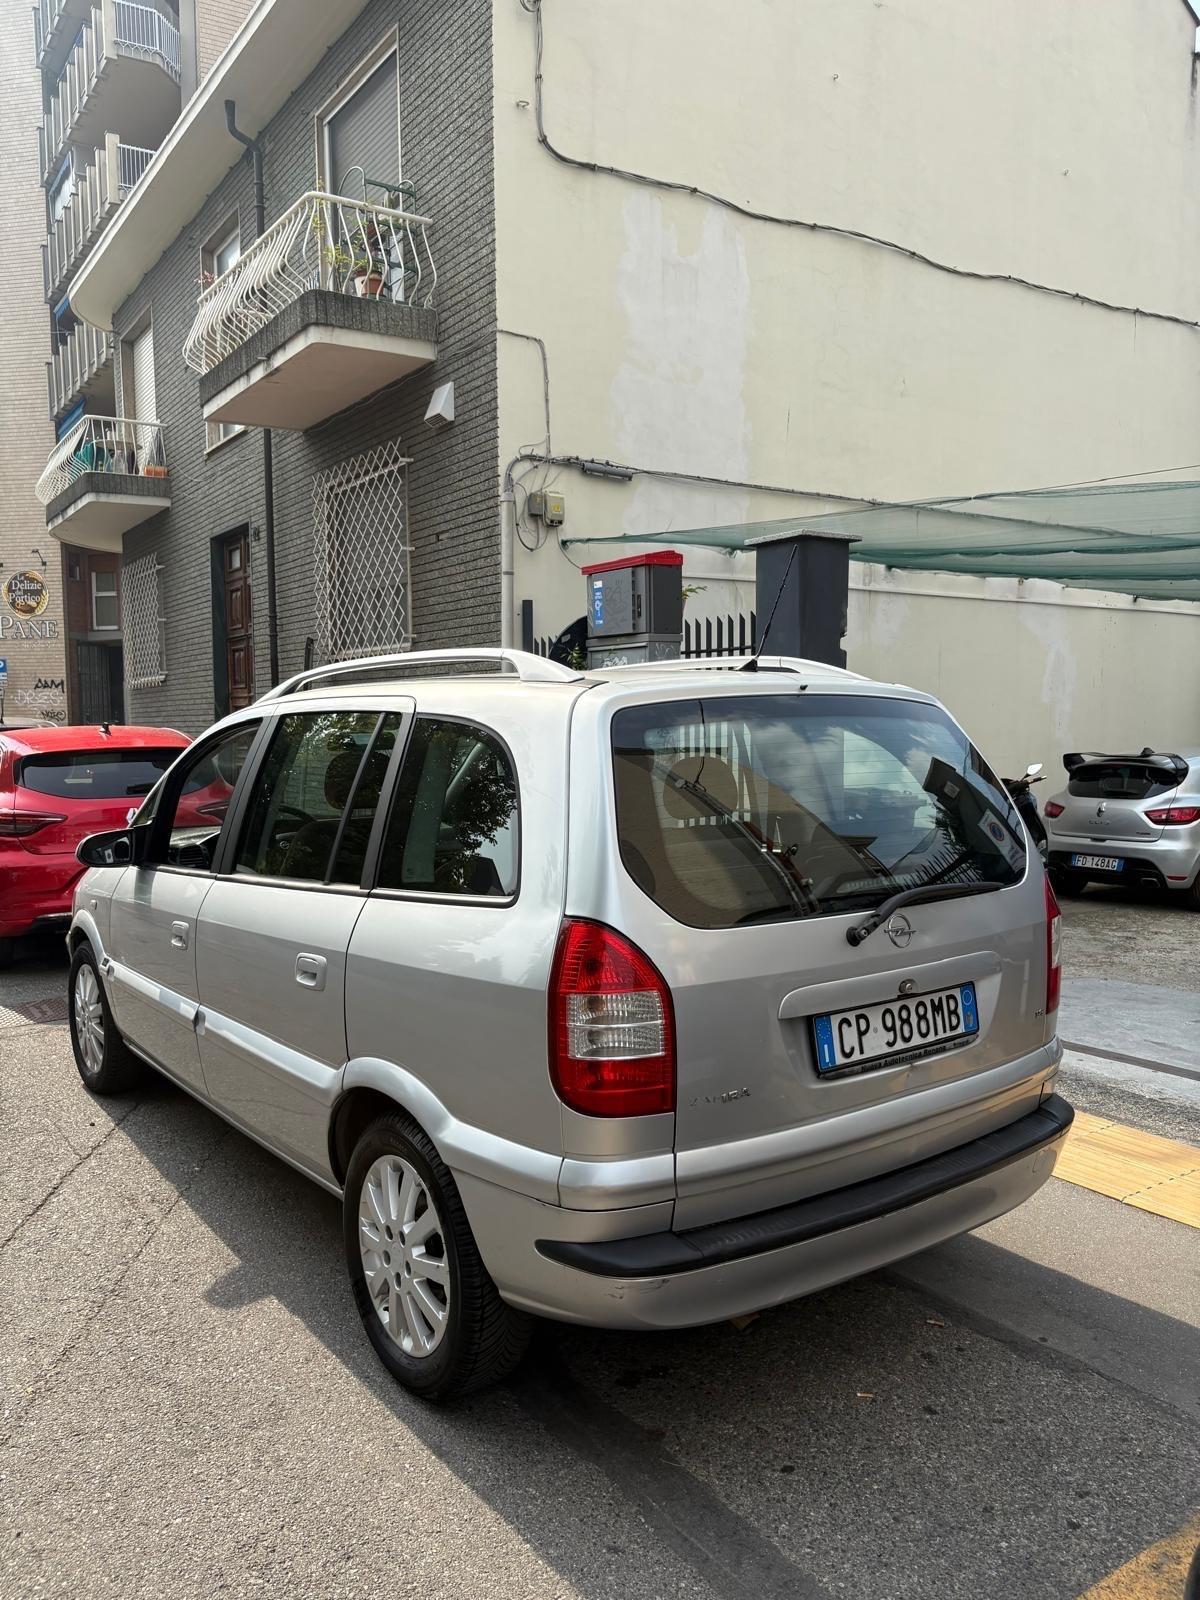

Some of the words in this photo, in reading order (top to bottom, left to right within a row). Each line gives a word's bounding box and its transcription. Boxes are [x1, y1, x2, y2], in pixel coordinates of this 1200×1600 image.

[12, 580, 42, 590] Delizie
[9, 592, 41, 603] Portico
[0, 615, 59, 640] PANE
[1076, 855, 1088, 866] FD
[1091, 857, 1117, 870] 148AG
[838, 1013, 871, 1059] CP
[881, 993, 962, 1048] 988MB
